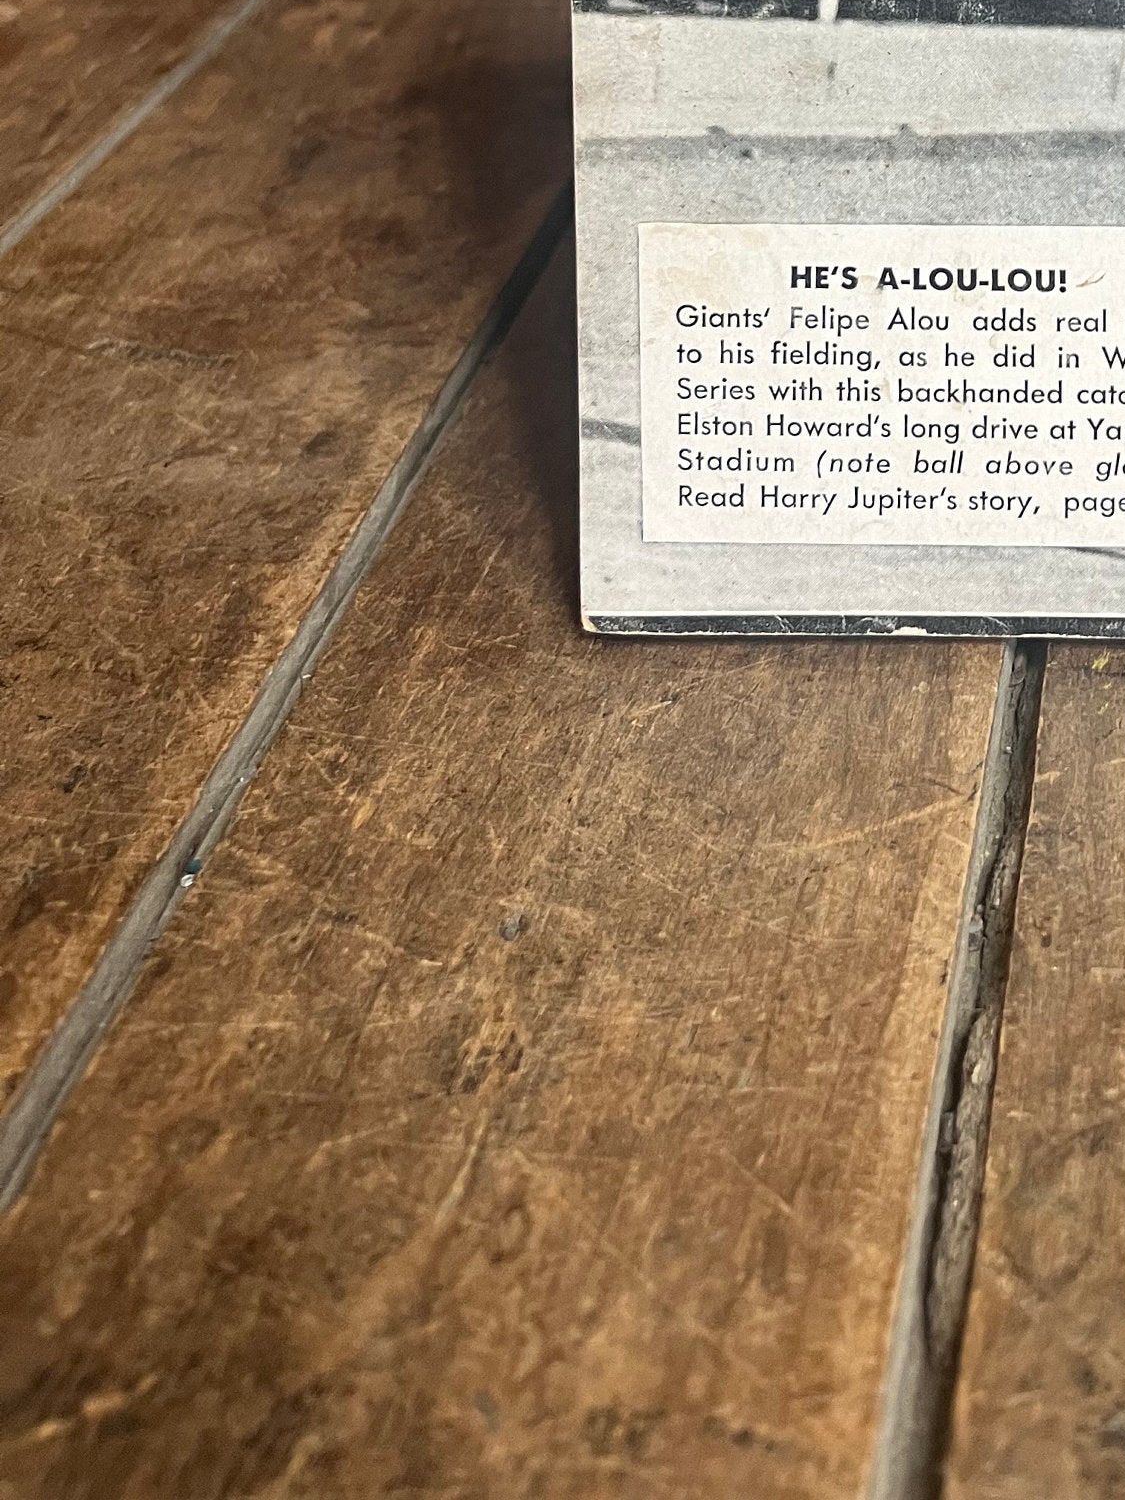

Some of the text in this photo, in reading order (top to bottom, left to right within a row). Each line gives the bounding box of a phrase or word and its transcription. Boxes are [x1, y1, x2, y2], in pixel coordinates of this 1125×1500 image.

[790, 265, 1067, 294] HE'S A-LOU-LOU!
[675, 304, 771, 329] Giants'
[790, 304, 870, 337] Felipe
[887, 306, 949, 331] Alou
[972, 307, 1037, 332] adds
[1056, 308, 1107, 333] real
[676, 343, 702, 364] to
[719, 341, 755, 365] his
[770, 341, 881, 372] fielding,
[898, 351, 928, 367] as
[944, 345, 975, 367] he
[993, 345, 1035, 368] did
[1058, 346, 1080, 369] in
[677, 377, 756, 401] Series
[768, 379, 823, 401] with
[836, 379, 881, 402] this
[898, 377, 1063, 404] backhanded
[678, 411, 753, 436] Elston
[766, 413, 891, 438] Howard's
[904, 413, 960, 445] long
[971, 414, 1039, 440] drive
[1049, 420, 1077, 440] at
[677, 447, 795, 473] Stadium
[816, 449, 891, 479] (note
[913, 449, 964, 474] ball
[985, 451, 1073, 476] above
[678, 483, 745, 508] Read
[760, 485, 838, 516] Harry
[847, 486, 958, 516] Jupiter's
[968, 490, 1041, 519] story,
